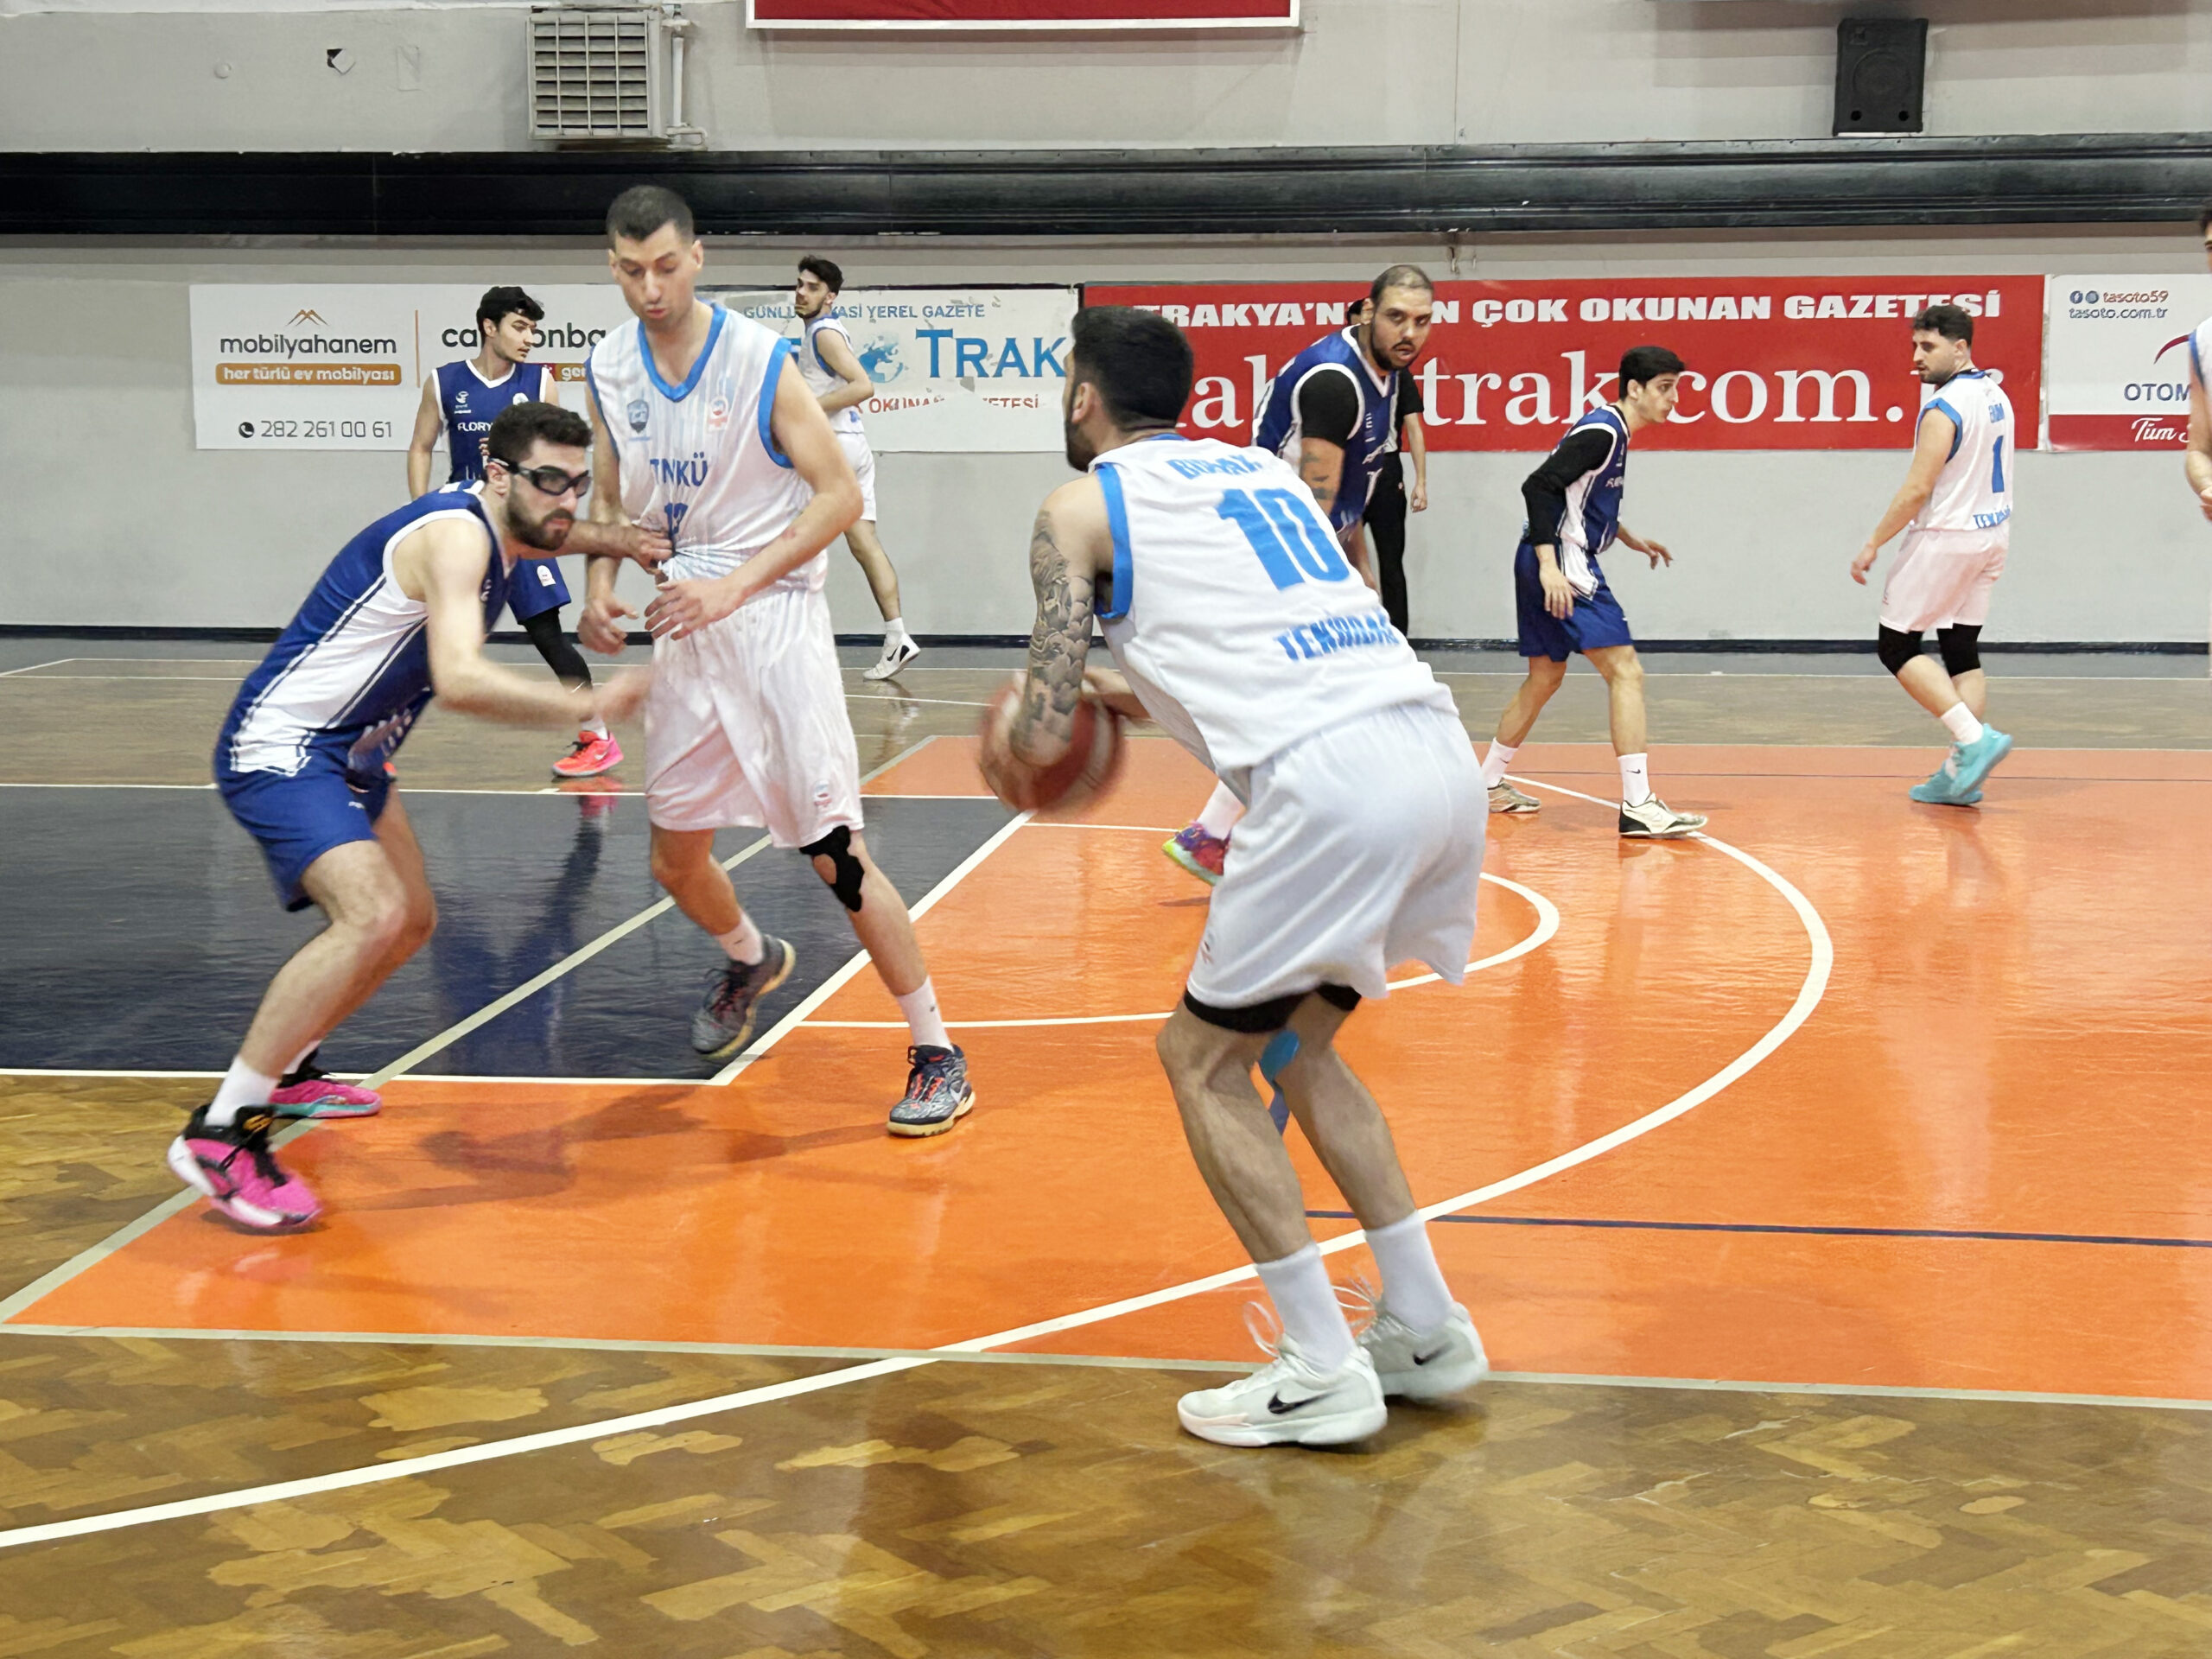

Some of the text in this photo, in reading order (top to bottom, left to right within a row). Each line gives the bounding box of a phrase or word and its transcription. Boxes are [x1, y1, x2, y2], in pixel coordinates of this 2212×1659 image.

[2103, 290, 2169, 303] tasoto59
[868, 306, 917, 318] YEREL
[922, 304, 985, 318] GAZETE
[1472, 299, 1568, 327] ÇOK
[1580, 296, 1771, 321] OKUNAN
[2069, 308, 2168, 319] tasoto.com.tr
[220, 334, 397, 359] mobilyahanem
[224, 367, 395, 385] her türlü ev mobilyası
[2124, 383, 2191, 402] OTOM
[261, 421, 392, 438] 282 261 00 61
[2131, 417, 2177, 442] Tüm
[1992, 435, 2005, 493] 1
[1215, 488, 1350, 592] 10
